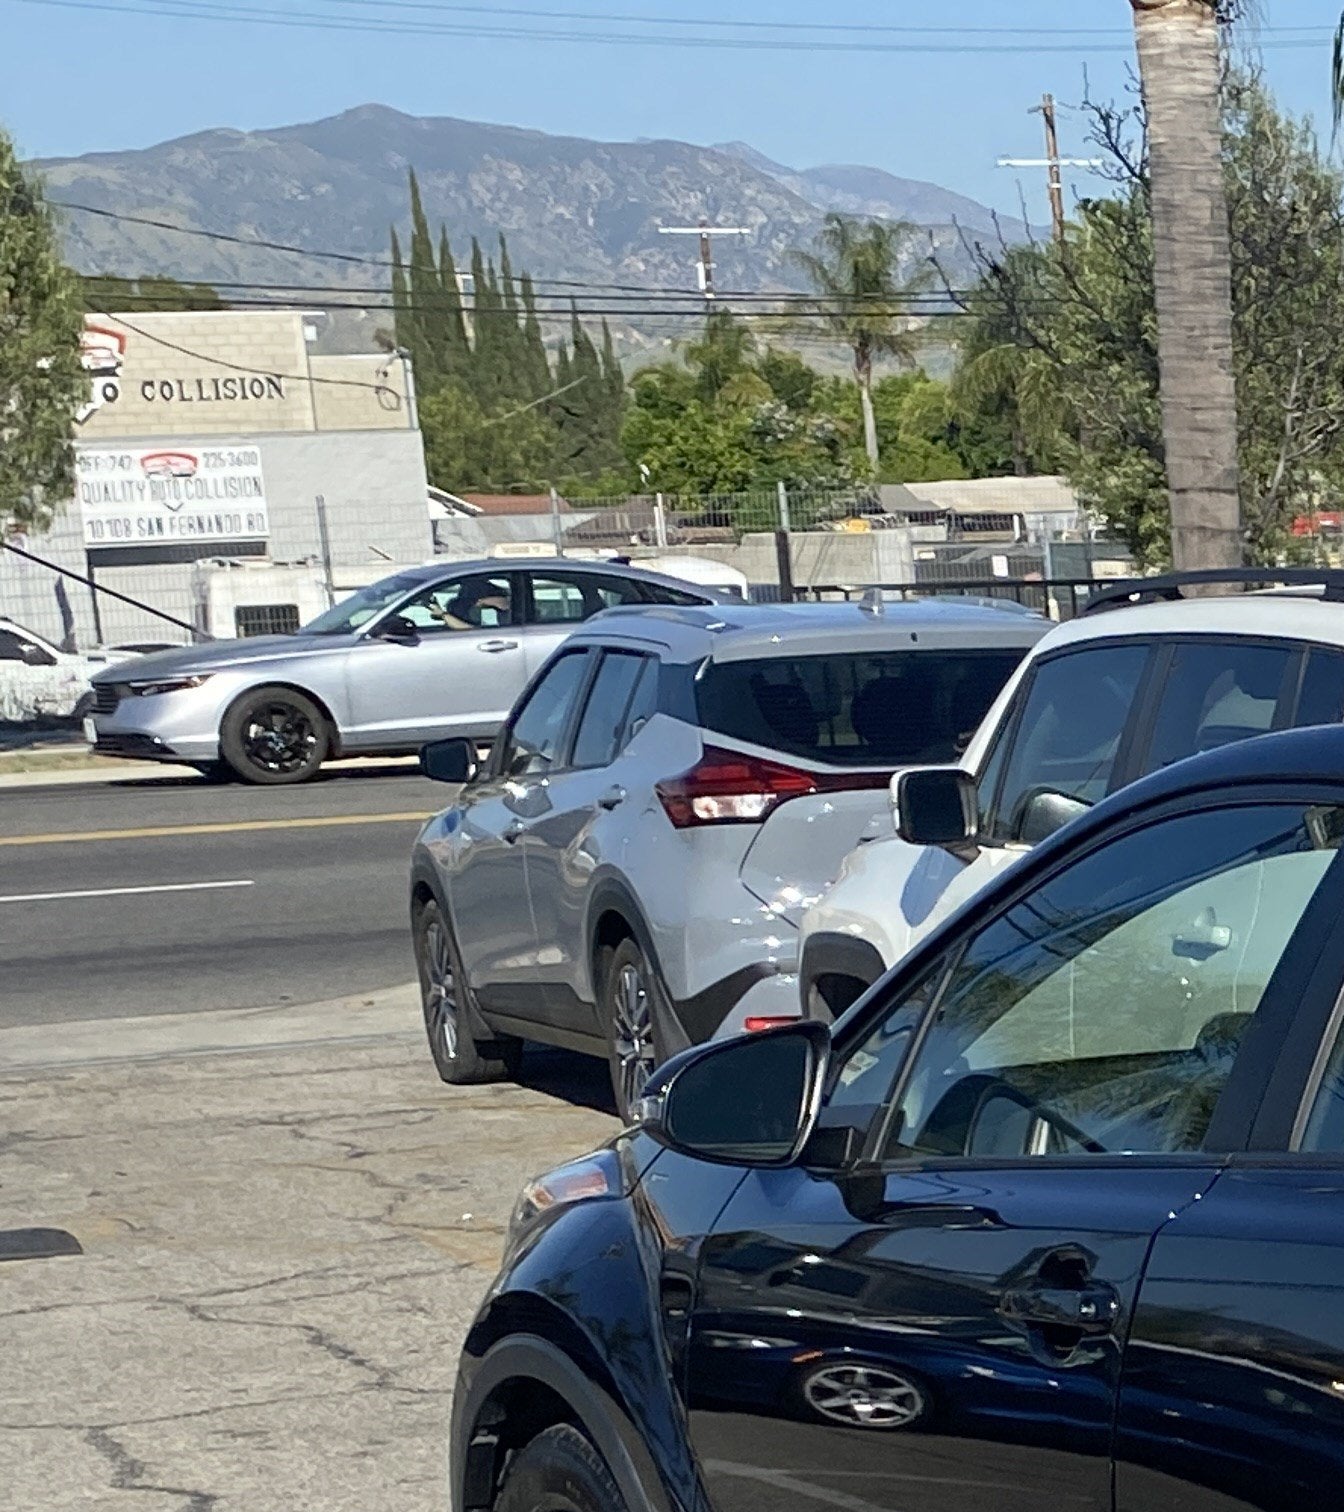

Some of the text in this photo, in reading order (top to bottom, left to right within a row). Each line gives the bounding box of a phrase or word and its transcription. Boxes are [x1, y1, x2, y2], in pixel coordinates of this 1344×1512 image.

[141, 376, 285, 401] COLLISION
[82, 479, 146, 504] QUALITY
[184, 475, 263, 500] COLLISION
[137, 515, 164, 536] SAN
[169, 512, 242, 535] FERNANDO
